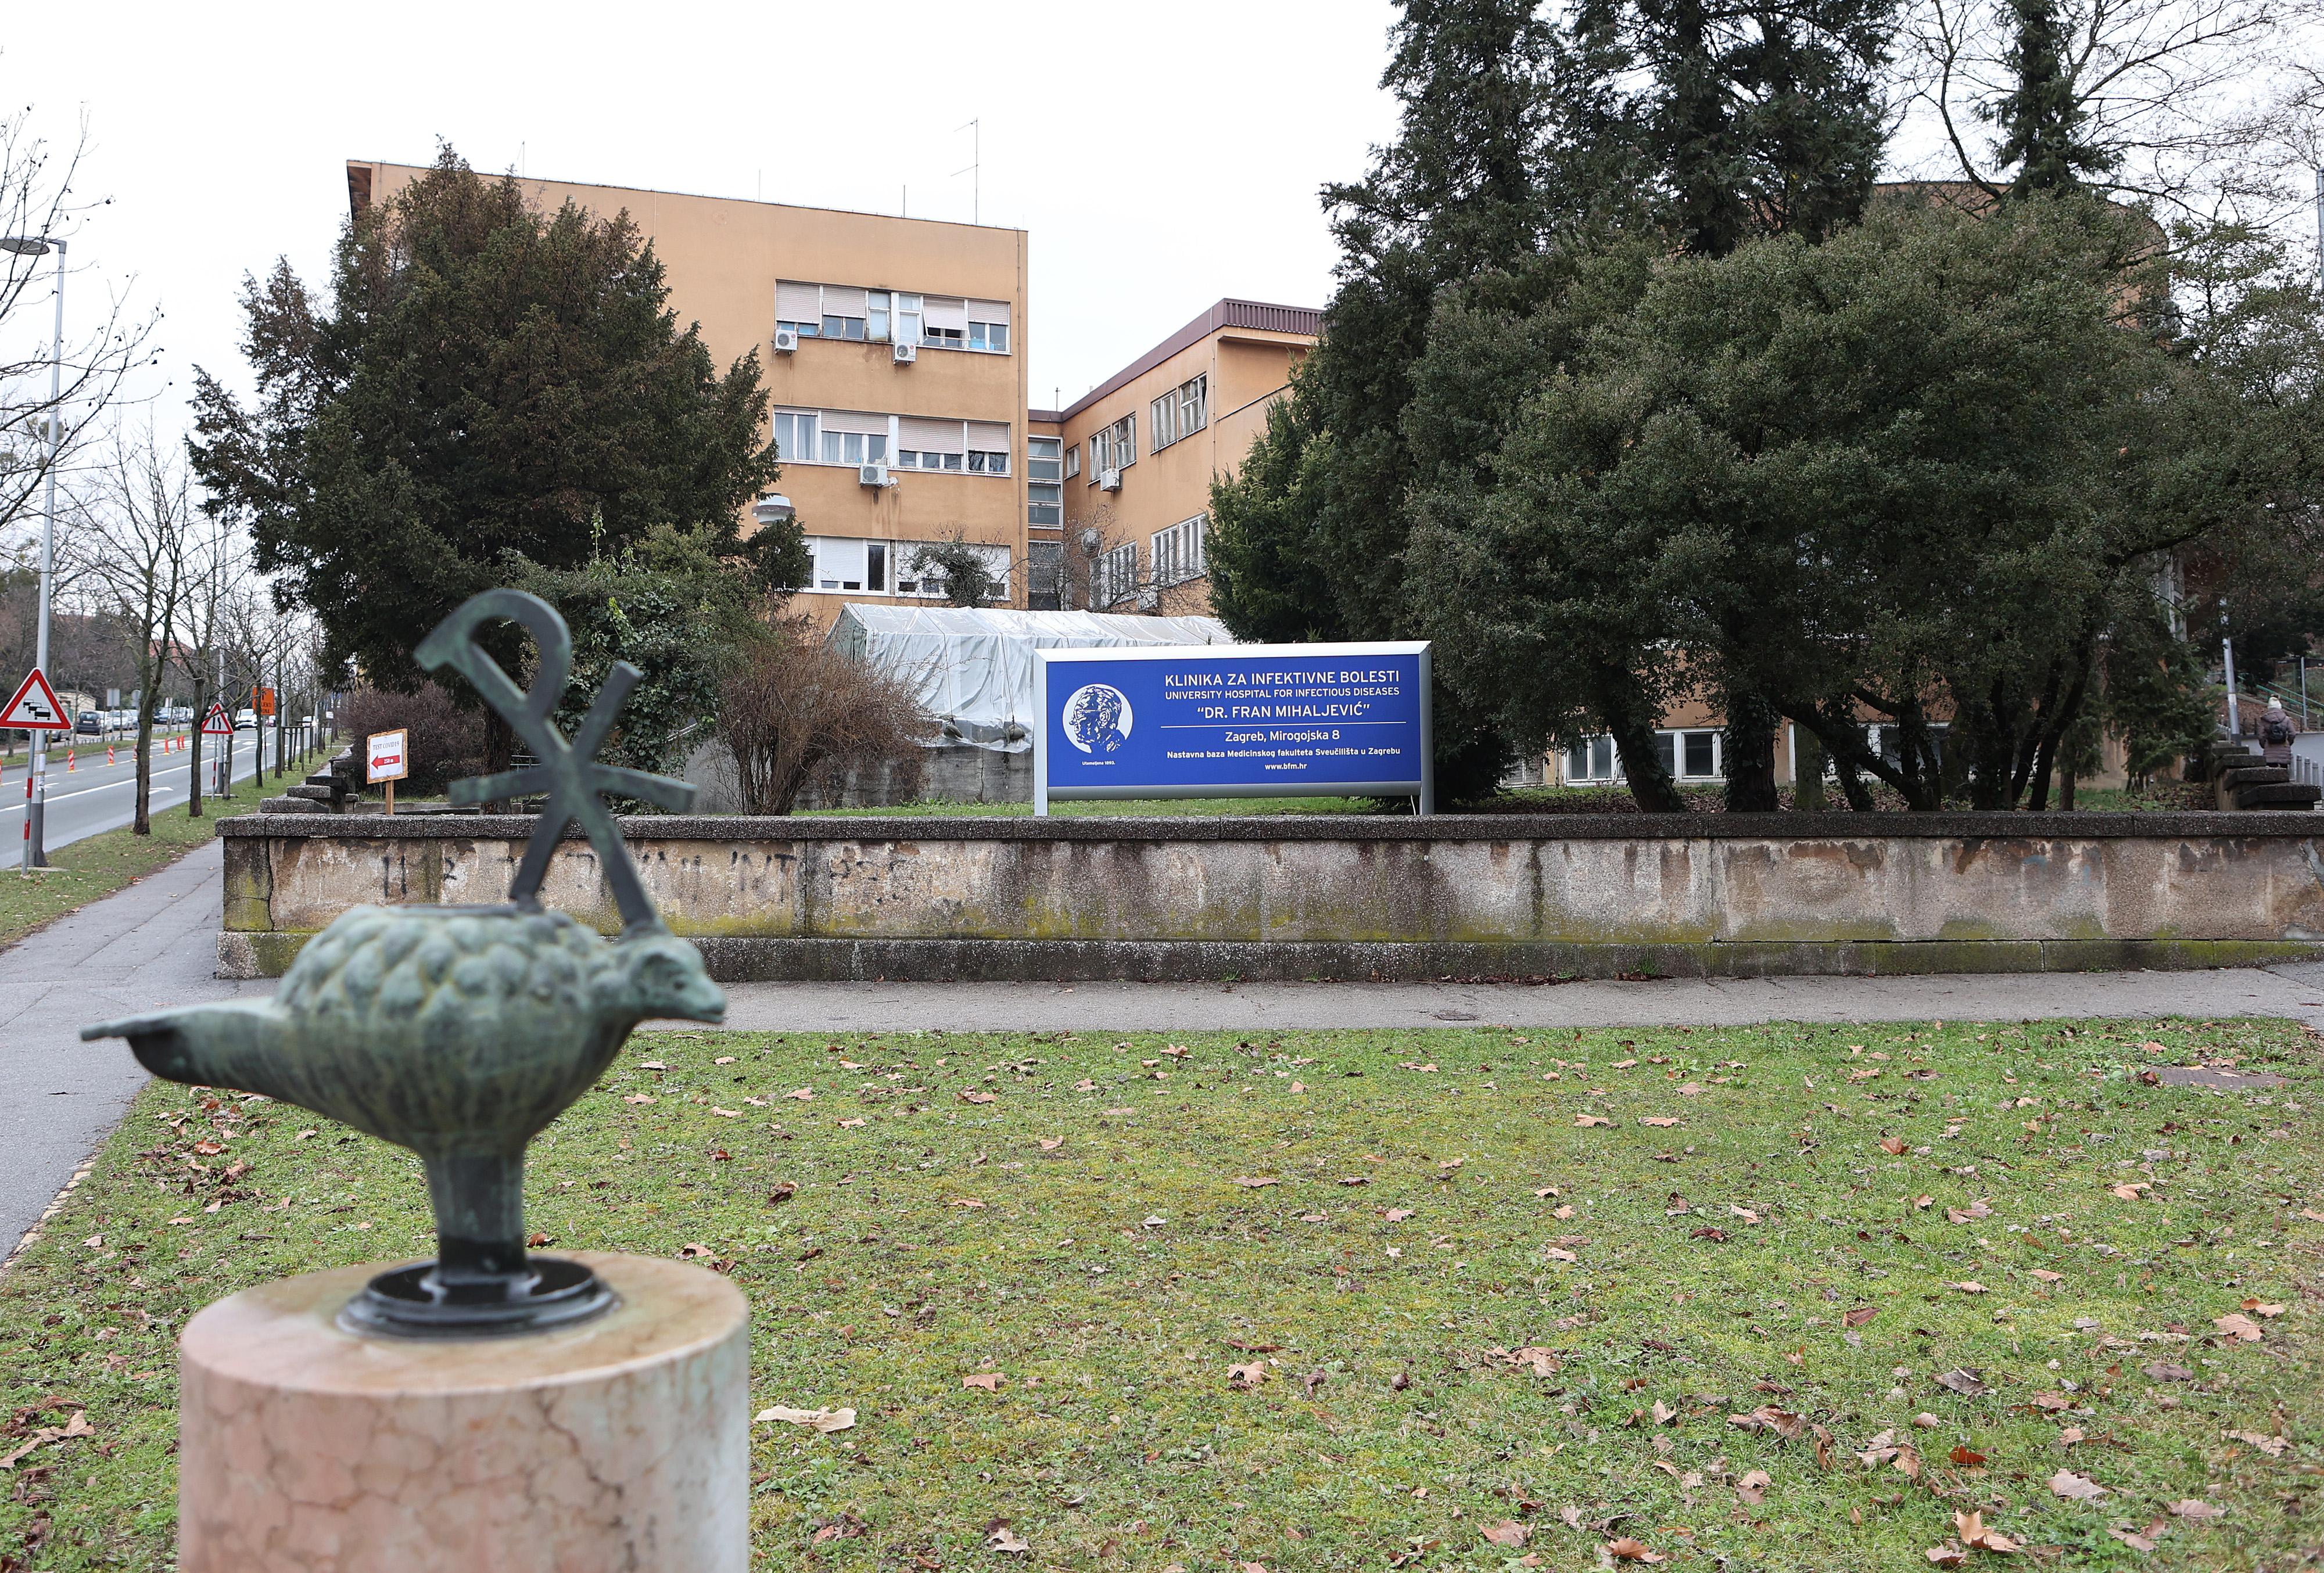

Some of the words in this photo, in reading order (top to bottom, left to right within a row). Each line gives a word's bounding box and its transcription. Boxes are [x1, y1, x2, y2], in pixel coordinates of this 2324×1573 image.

[1165, 674, 1223, 687] KLINIKA
[1227, 673, 1247, 685] ZA
[1251, 671, 1336, 685] INFEKTIVNE
[1340, 670, 1400, 683] BOLESTI
[1165, 691, 1222, 700] UNIVERSITY
[1225, 689, 1271, 699] HOSPITAL
[1274, 689, 1293, 698] FOR
[1295, 688, 1351, 697] INFECTIOUS
[1354, 687, 1400, 696] DISEASES
[1232, 706, 1271, 718] FRAN
[1225, 731, 1267, 744] Zagreb,
[1270, 730, 1329, 742] Mirogojska
[1332, 730, 1340, 740] 8
[1167, 750, 1204, 759] Nastavna
[1227, 749, 1275, 758] Medicinskog
[1315, 748, 1359, 756] Sveučilišta
[1368, 747, 1401, 756] Zagrebu
